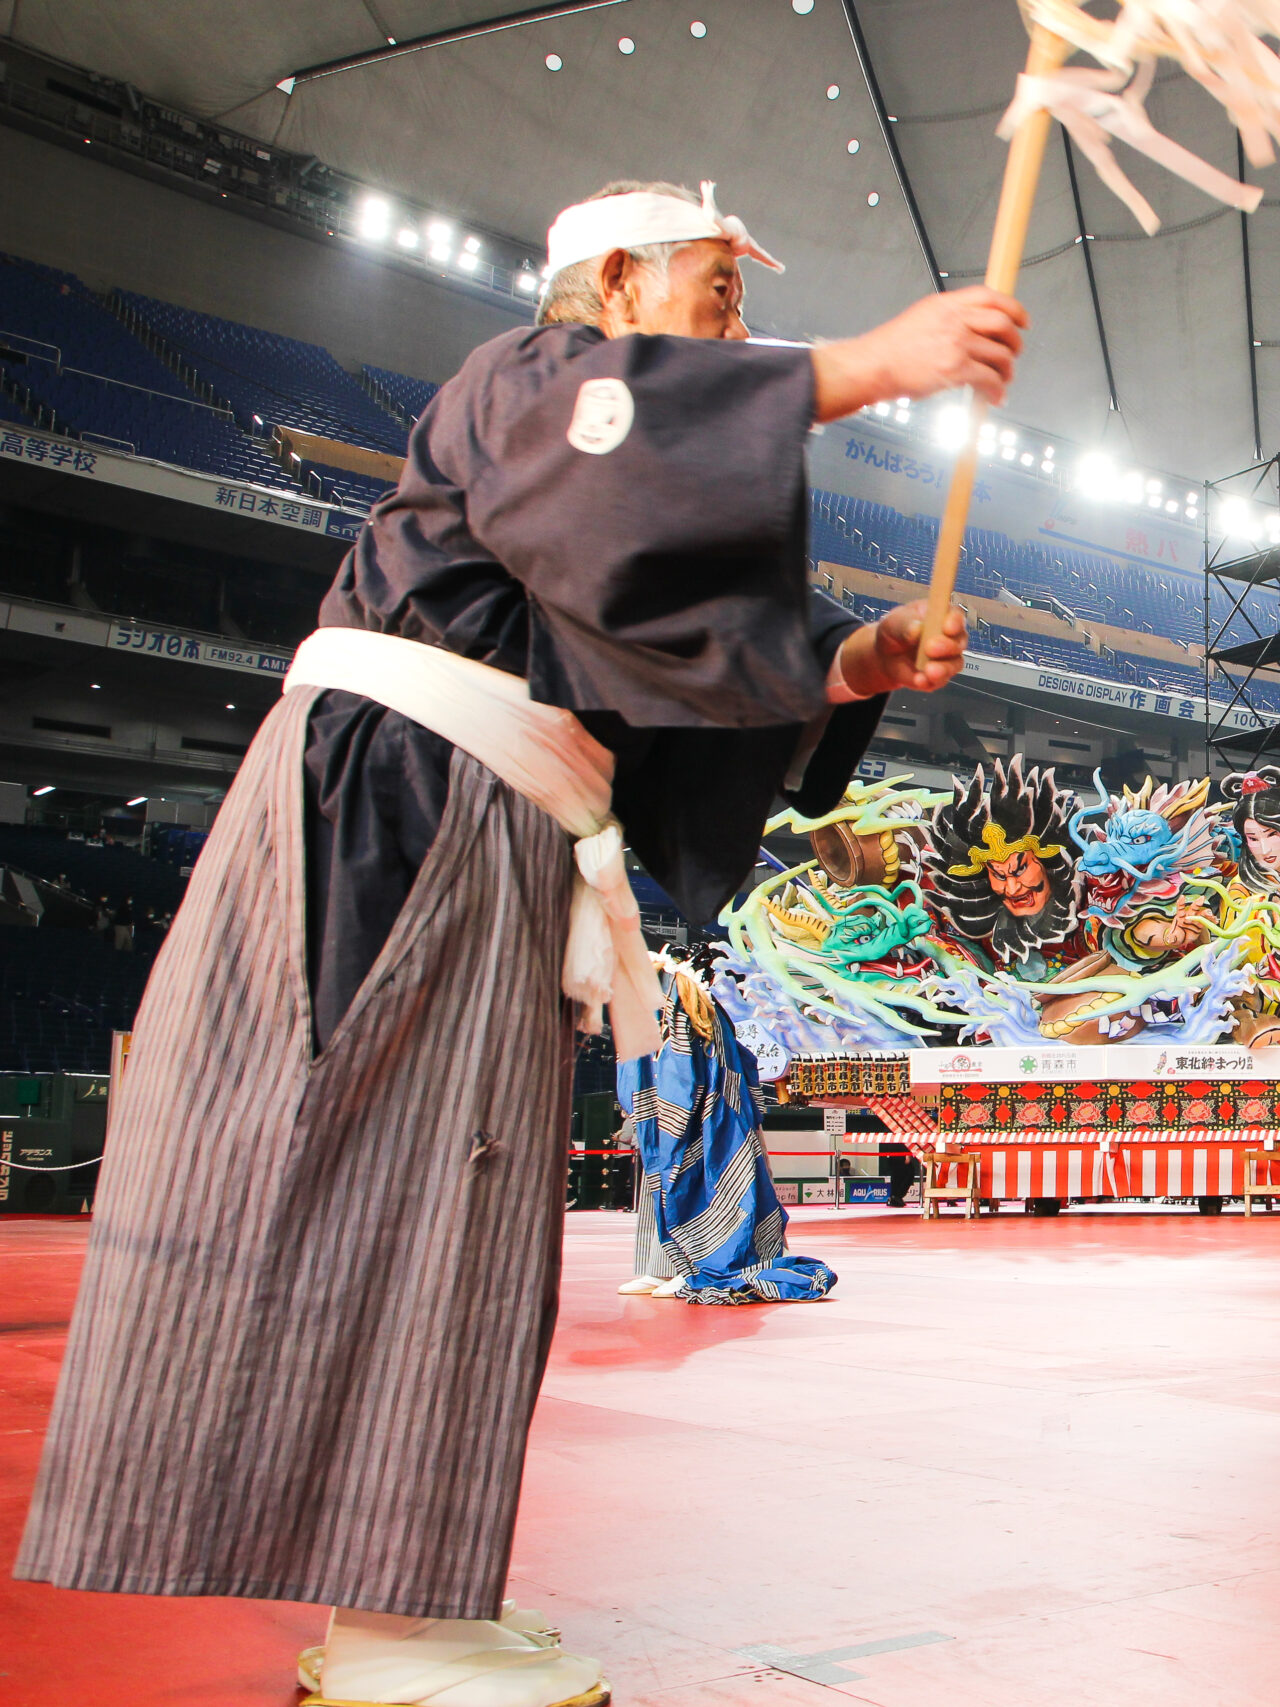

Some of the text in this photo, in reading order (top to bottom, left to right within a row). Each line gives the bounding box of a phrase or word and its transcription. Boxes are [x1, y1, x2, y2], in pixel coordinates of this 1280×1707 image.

[0, 431, 98, 474] 高等学校
[215, 485, 323, 528] 新日本空調
[211, 648, 253, 665] FM92.4
[1038, 674, 1195, 719] DESIGN & DISPLAY 作画会
[1041, 1059, 1080, 1071] 青森市
[1175, 1056, 1246, 1071] 東北絆まつり
[852, 1186, 888, 1200] AQUARIUS
